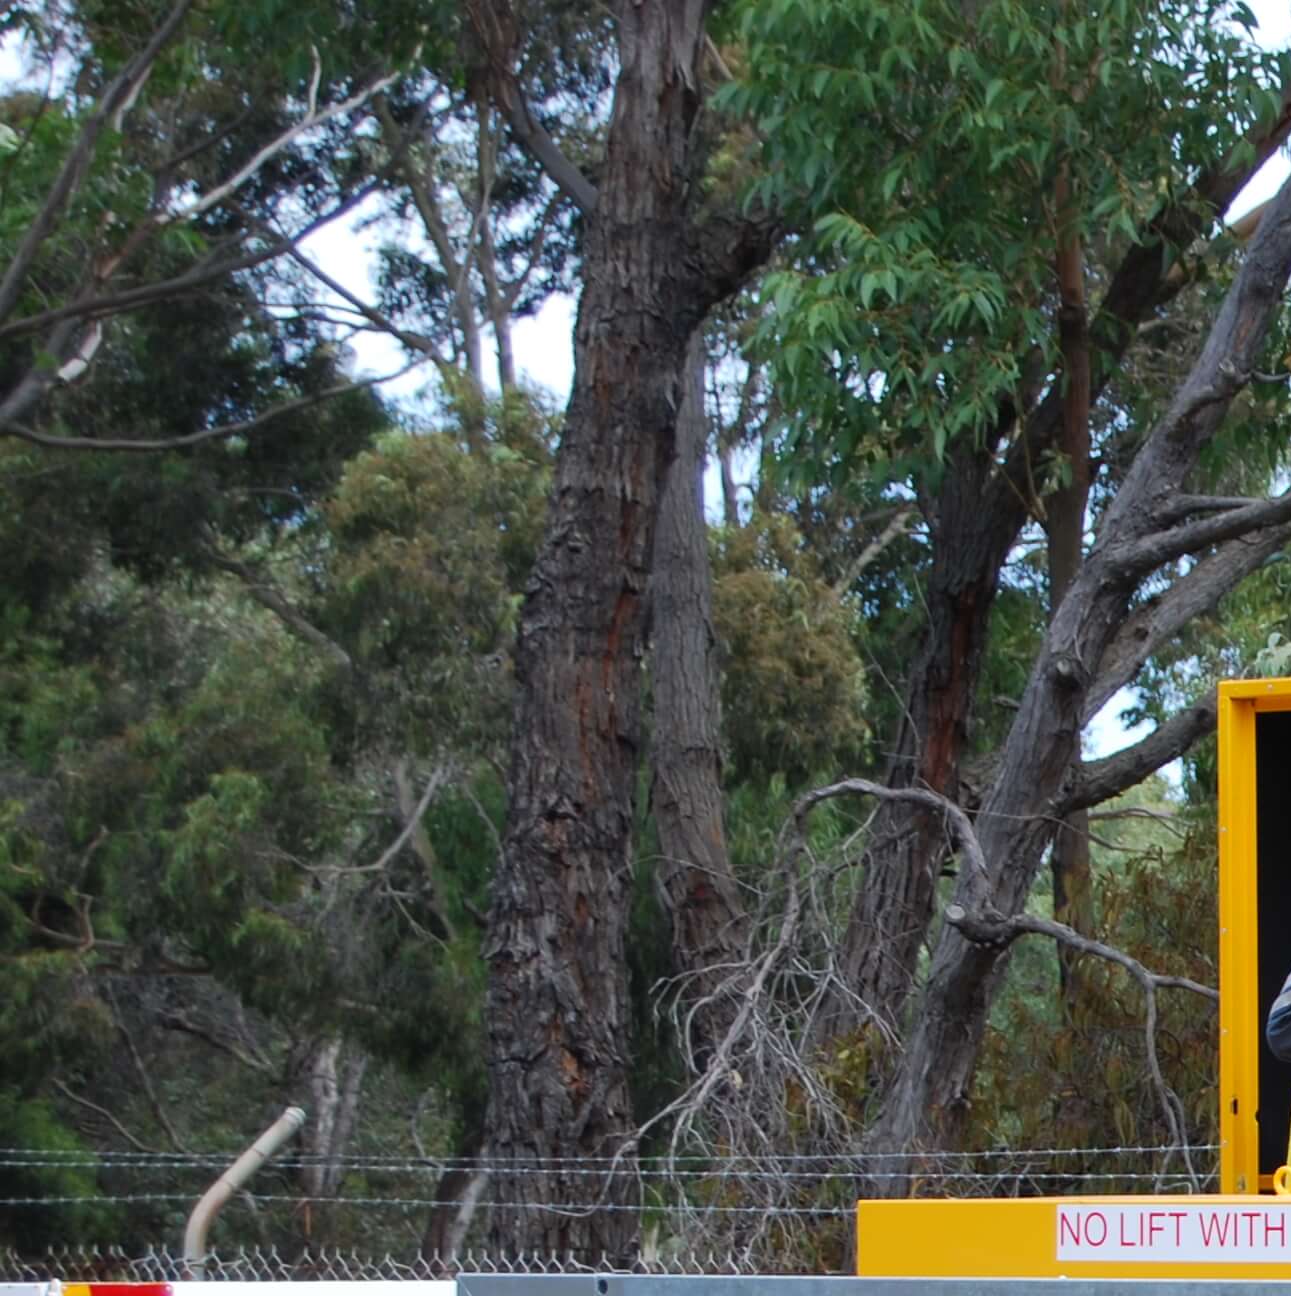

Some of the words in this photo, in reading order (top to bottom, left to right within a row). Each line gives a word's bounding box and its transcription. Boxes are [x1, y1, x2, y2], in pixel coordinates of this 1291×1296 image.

[1060, 1212, 1108, 1247] NO
[1119, 1212, 1188, 1247] LIFT
[1199, 1212, 1285, 1247] WITH
